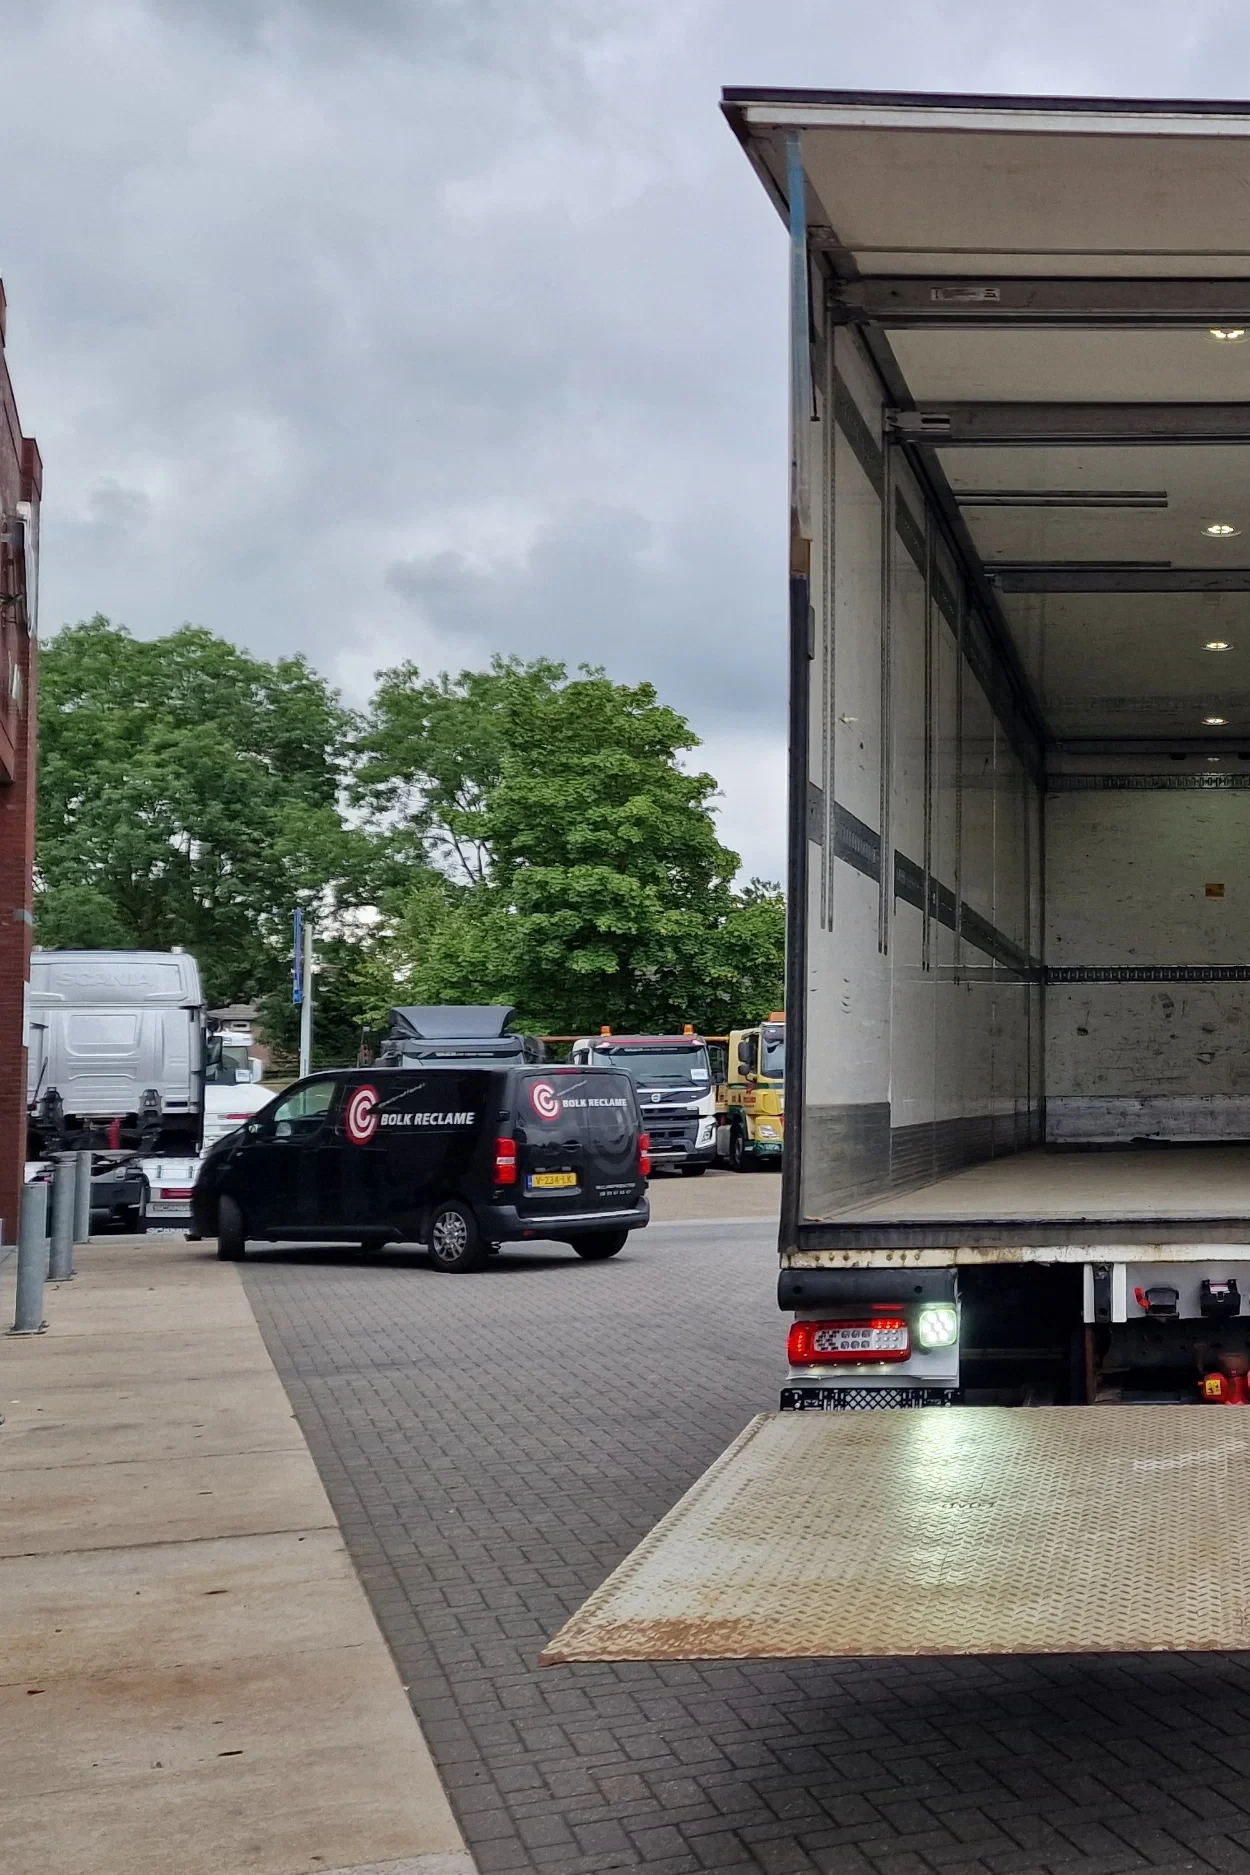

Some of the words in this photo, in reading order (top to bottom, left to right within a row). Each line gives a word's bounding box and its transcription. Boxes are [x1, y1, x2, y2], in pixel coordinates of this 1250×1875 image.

[562, 1099, 588, 1108] BOLK
[588, 1098, 628, 1107] RECLAME
[380, 1113, 413, 1126] BOLK
[413, 1112, 476, 1125] RECLAME
